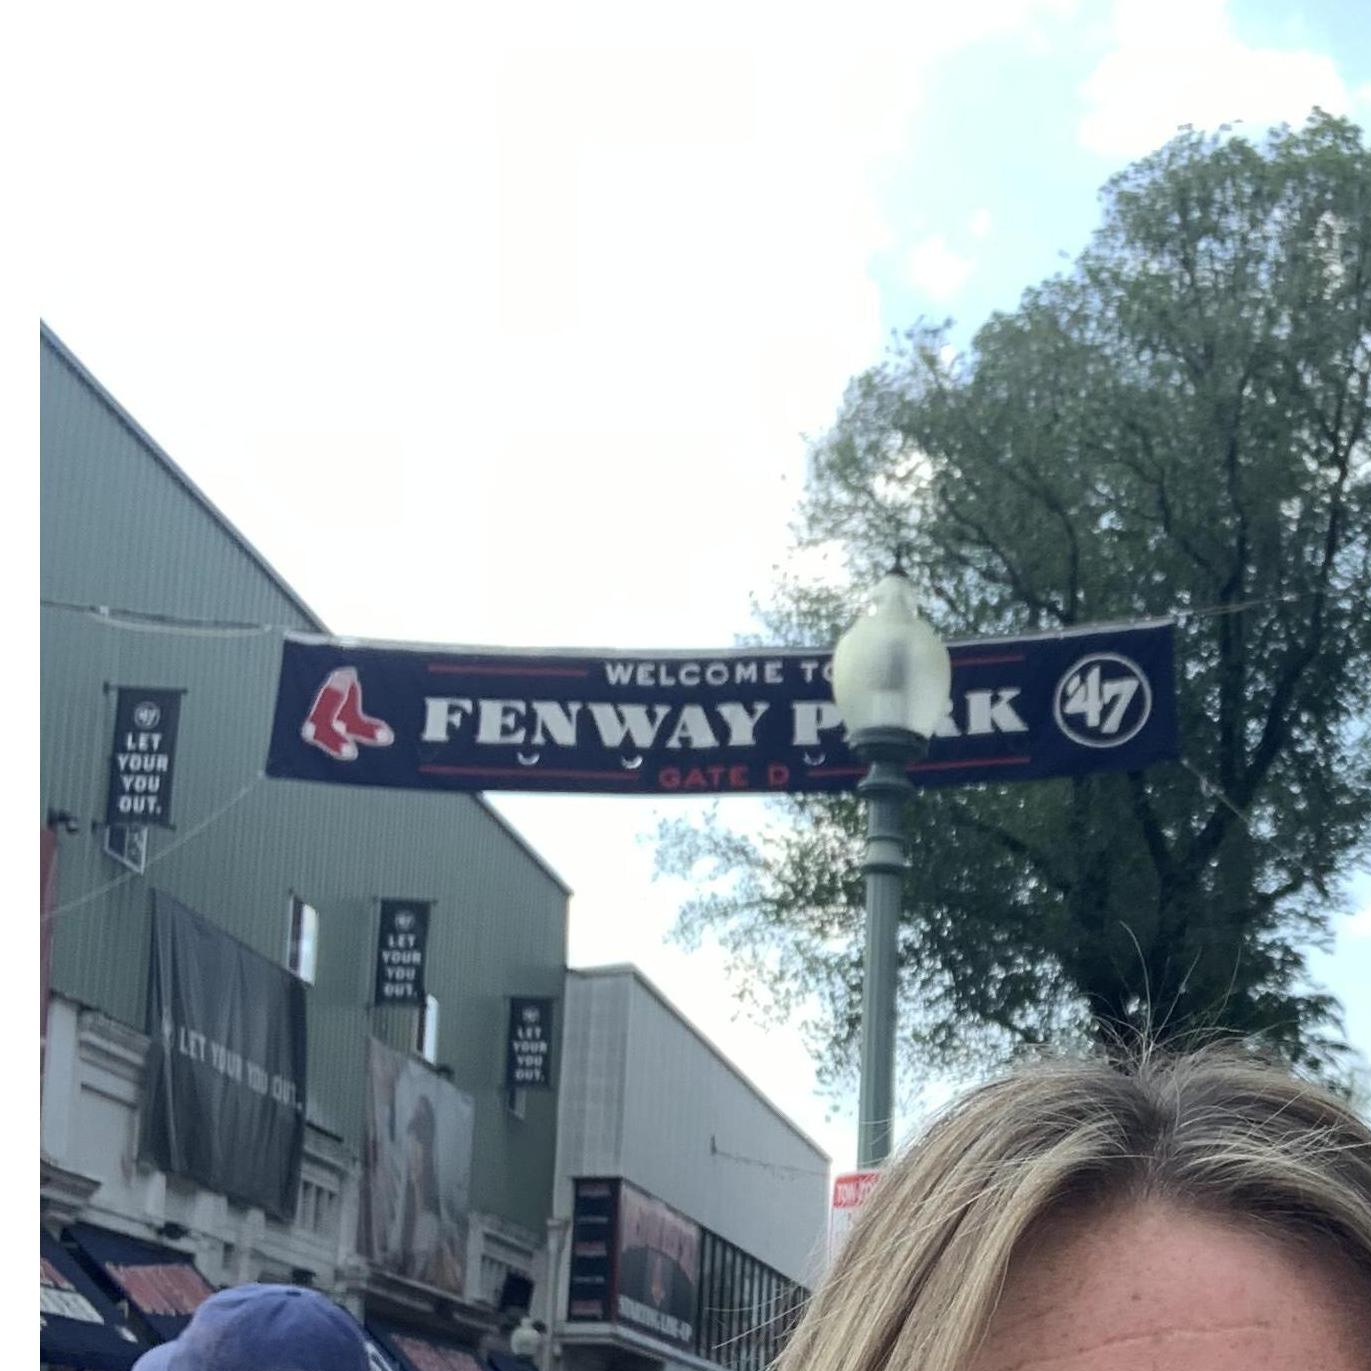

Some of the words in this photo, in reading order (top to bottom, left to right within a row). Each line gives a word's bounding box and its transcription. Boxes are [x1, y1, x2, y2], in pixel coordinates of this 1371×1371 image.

[604, 661, 783, 685] WELCOME
[421, 697, 770, 748] FENWAY
[792, 687, 1029, 746] PK
[126, 731, 162, 752] LET
[117, 752, 169, 772] YOUR
[121, 774, 160, 793] YOU
[658, 764, 748, 788] GATE
[768, 763, 790, 786] D
[118, 794, 162, 814] OUT.
[388, 933, 416, 948] LET
[382, 950, 422, 965] YOUR
[386, 966, 416, 980] YOU
[517, 1025, 542, 1040] LET
[179, 1026, 206, 1062] LET
[516, 1055, 543, 1067] YOU
